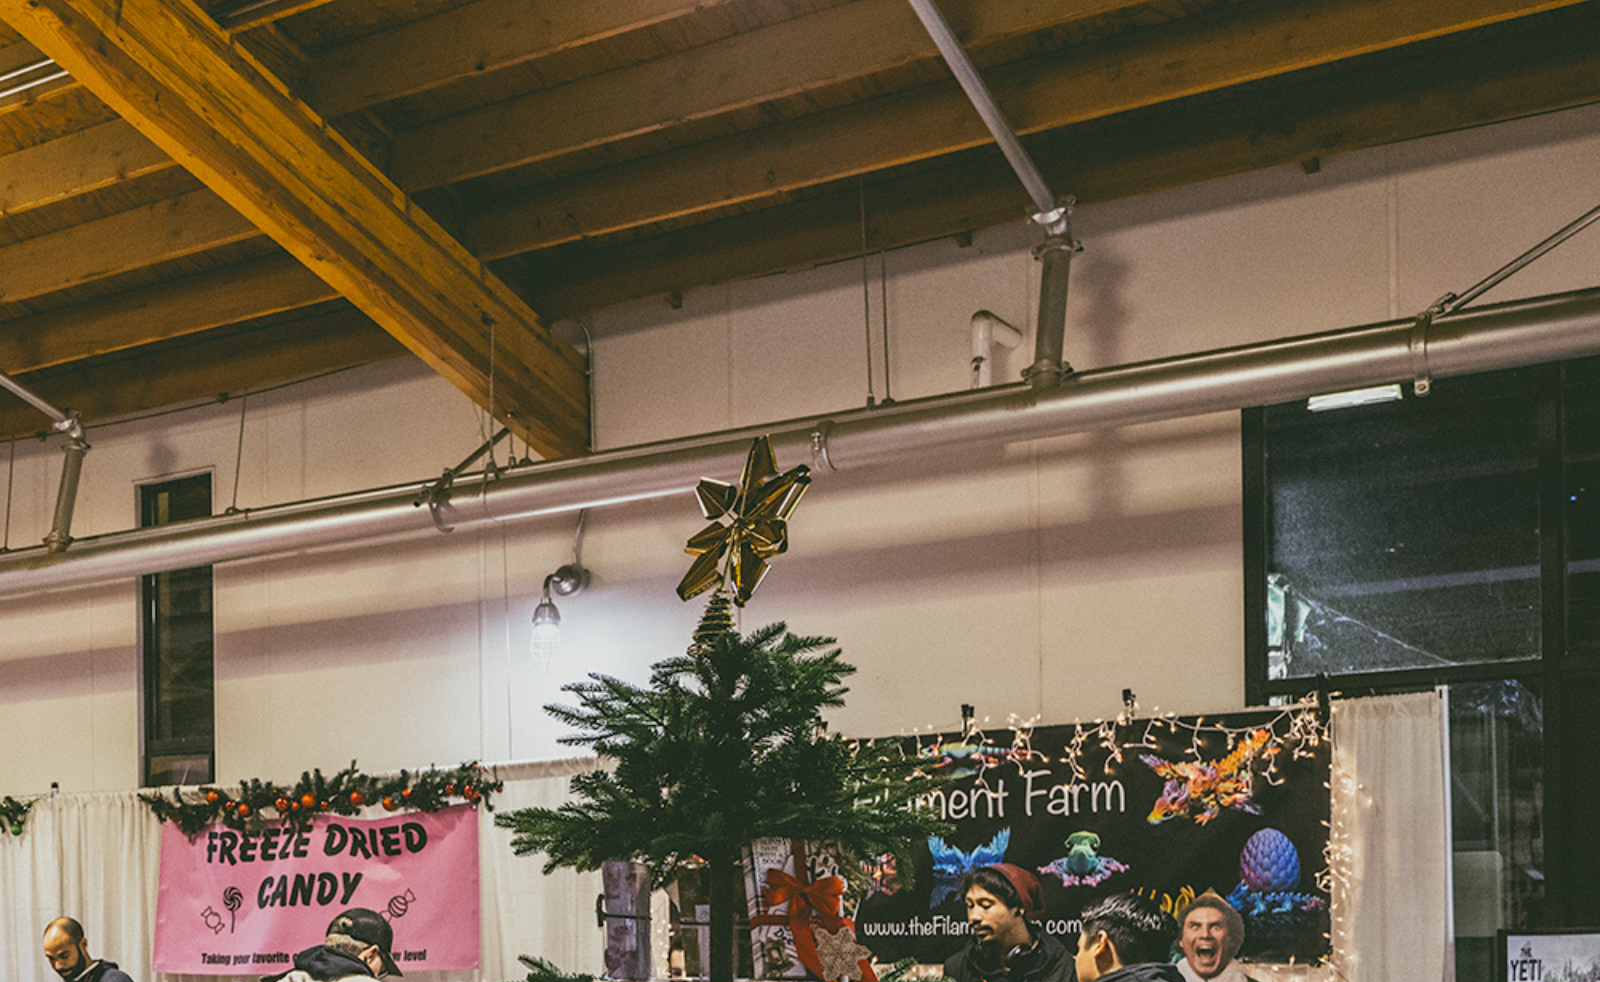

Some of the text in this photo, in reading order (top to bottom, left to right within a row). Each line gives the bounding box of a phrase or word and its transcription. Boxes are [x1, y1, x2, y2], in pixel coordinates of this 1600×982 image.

[1024, 769, 1126, 816] Farm
[206, 821, 428, 866] FREEZE DRIED
[257, 871, 363, 909] CANDY
[201, 953, 230, 966] Taking
[233, 955, 250, 965] your
[252, 951, 290, 964] favorite
[403, 949, 427, 962] level
[1510, 959, 1542, 981] YETI
